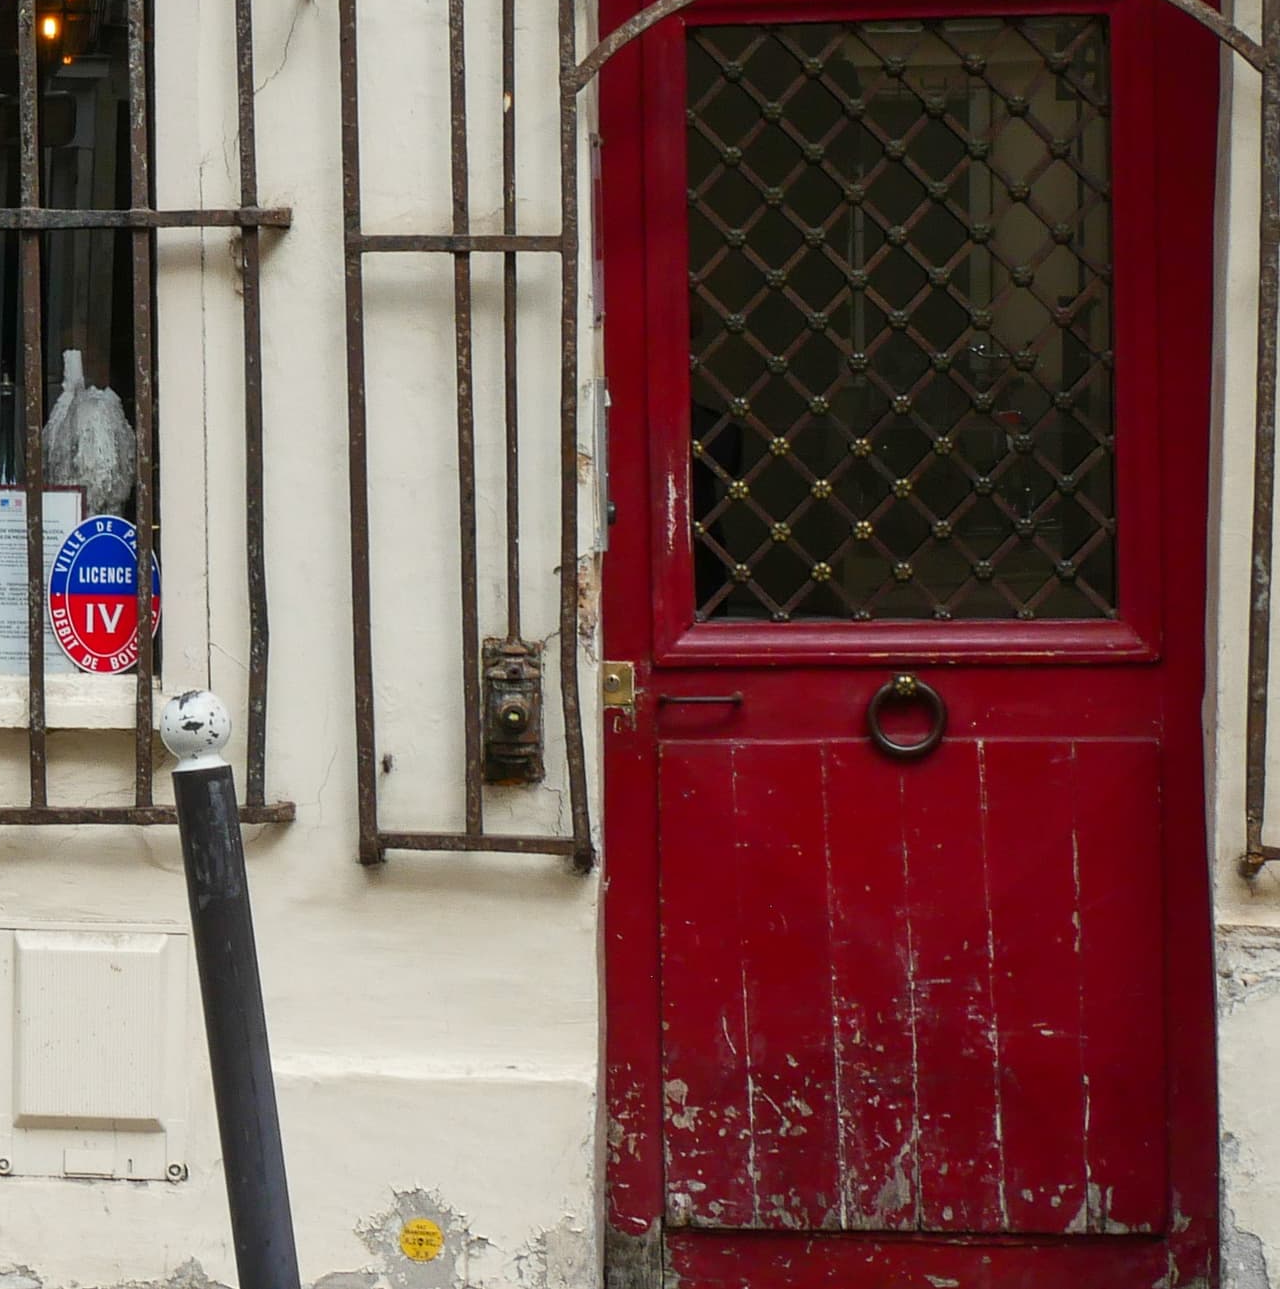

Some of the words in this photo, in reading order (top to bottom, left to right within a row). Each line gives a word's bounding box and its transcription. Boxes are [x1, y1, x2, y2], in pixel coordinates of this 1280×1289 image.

[54, 530, 86, 573] VILLE
[96, 520, 113, 533] DE
[79, 565, 132, 585] LICENCE
[53, 608, 80, 651] DEBIT
[81, 655, 99, 670] DE
[85, 603, 125, 634] IV
